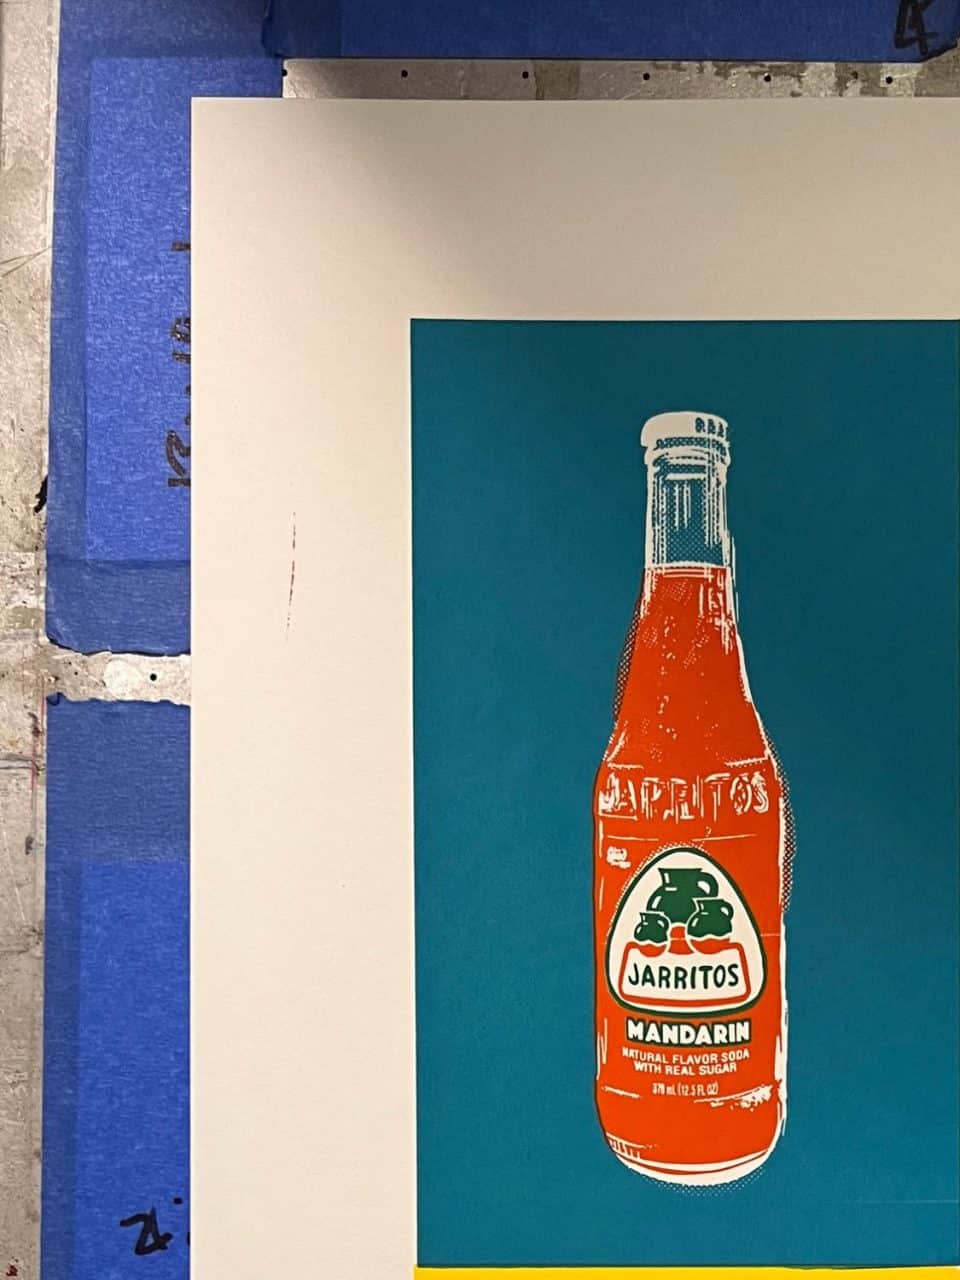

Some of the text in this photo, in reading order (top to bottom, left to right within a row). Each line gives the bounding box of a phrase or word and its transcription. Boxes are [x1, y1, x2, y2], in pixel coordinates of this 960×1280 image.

[628, 963, 739, 989] JARRITOS
[627, 1018, 750, 1045] MANDARIN
[622, 1046, 750, 1065] NATURAL FLAVOR SODA
[634, 1061, 737, 1076] WITH REAL SUGAR
